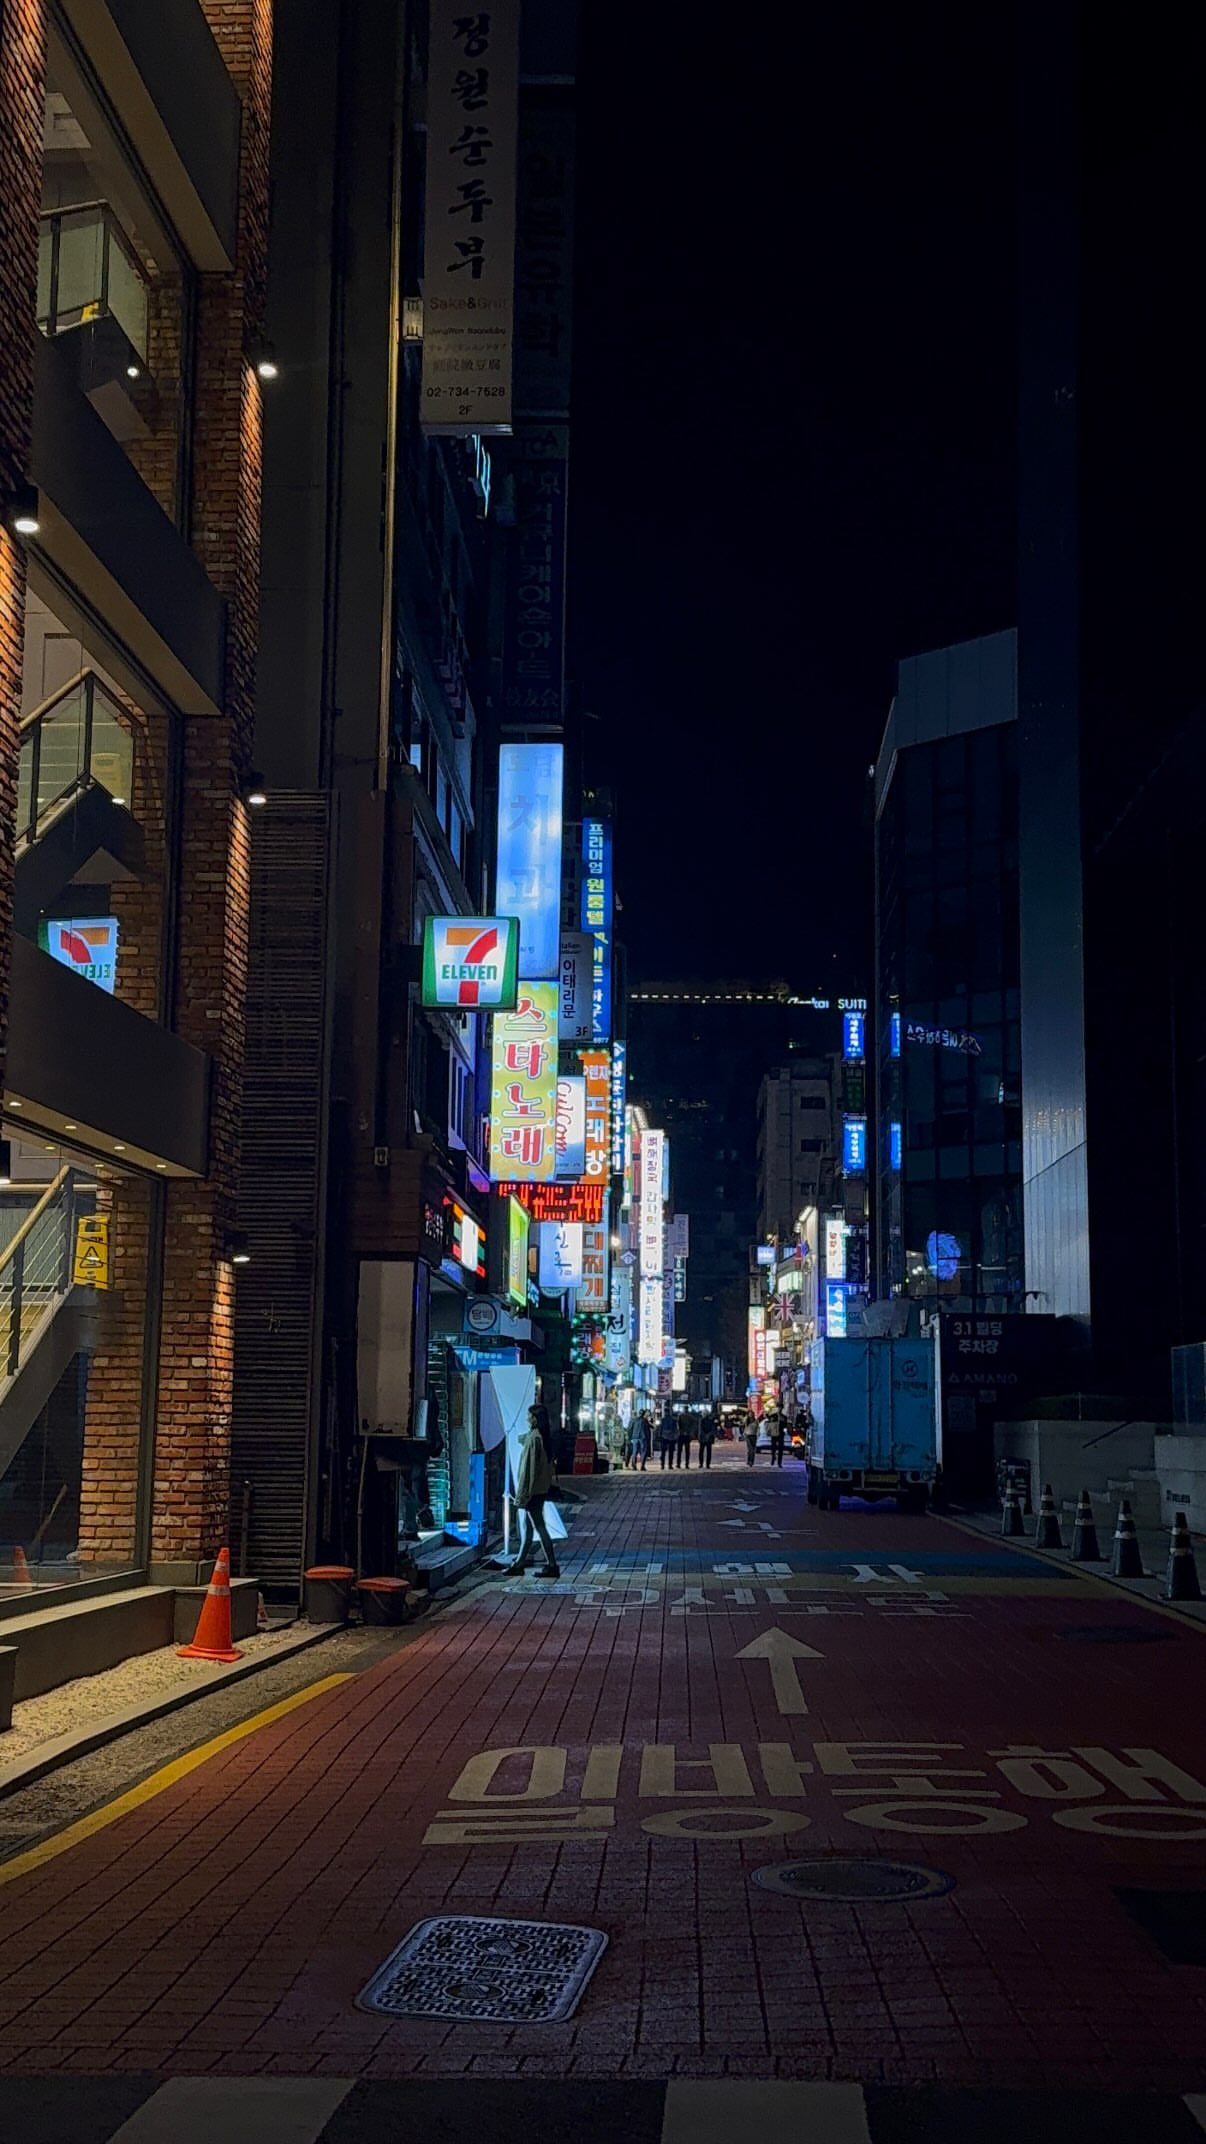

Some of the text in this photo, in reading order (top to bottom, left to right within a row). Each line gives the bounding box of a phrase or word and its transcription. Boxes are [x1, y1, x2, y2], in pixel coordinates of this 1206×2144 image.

[588, 823, 604, 875] 프리미엄
[575, 1026, 589, 1037] 3F
[957, 1338, 1000, 1355] 주차장
